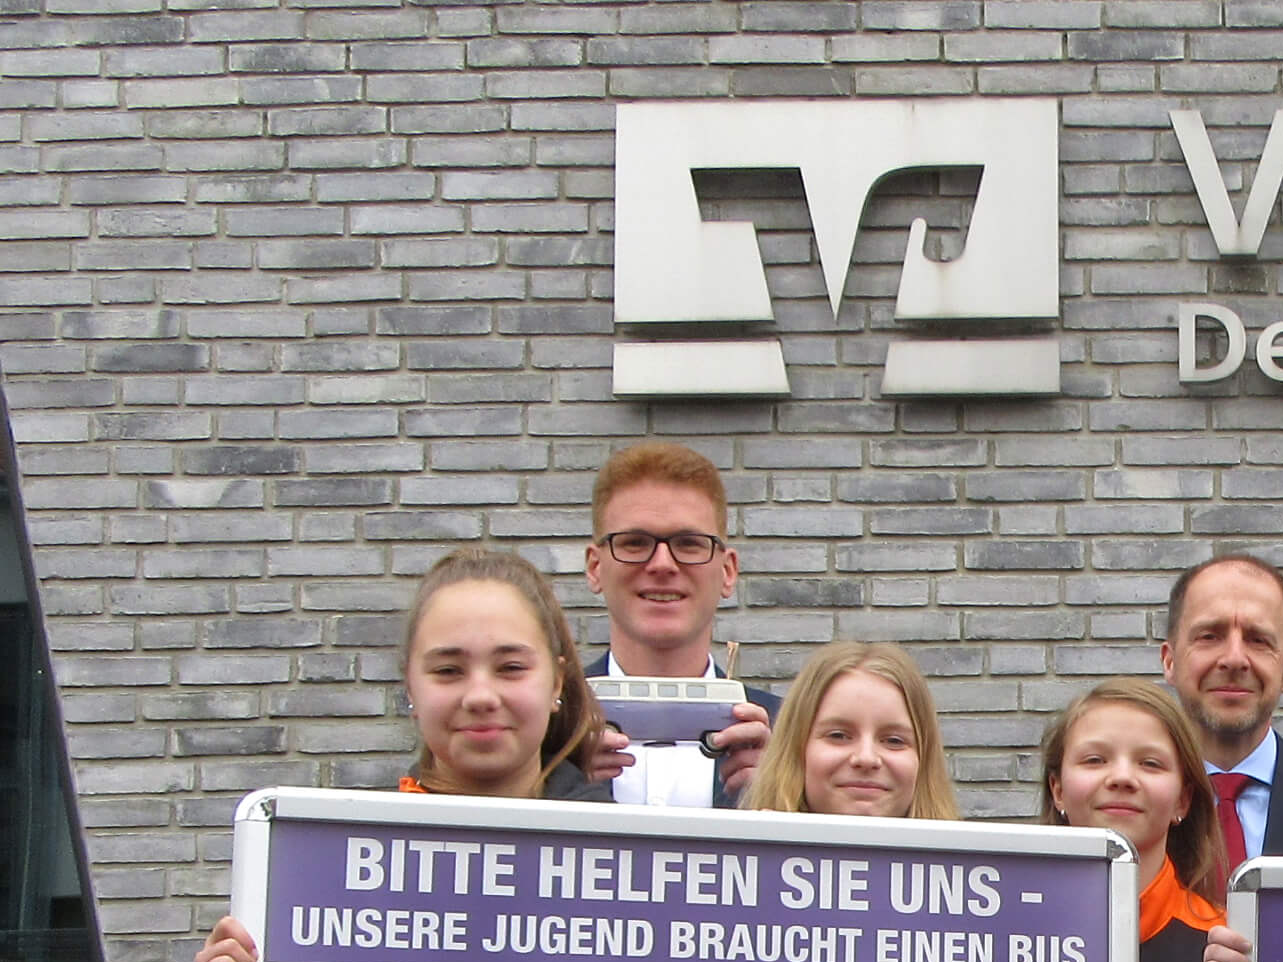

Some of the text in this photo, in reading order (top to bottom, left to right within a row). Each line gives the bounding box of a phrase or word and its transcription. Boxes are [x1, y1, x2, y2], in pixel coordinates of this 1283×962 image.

[345, 836, 516, 897] BITTE
[538, 846, 759, 908] HELFEN
[779, 856, 870, 912] SIE
[889, 861, 1001, 918] UNS
[291, 905, 468, 951] UNSERE
[482, 914, 654, 958] JUGEND
